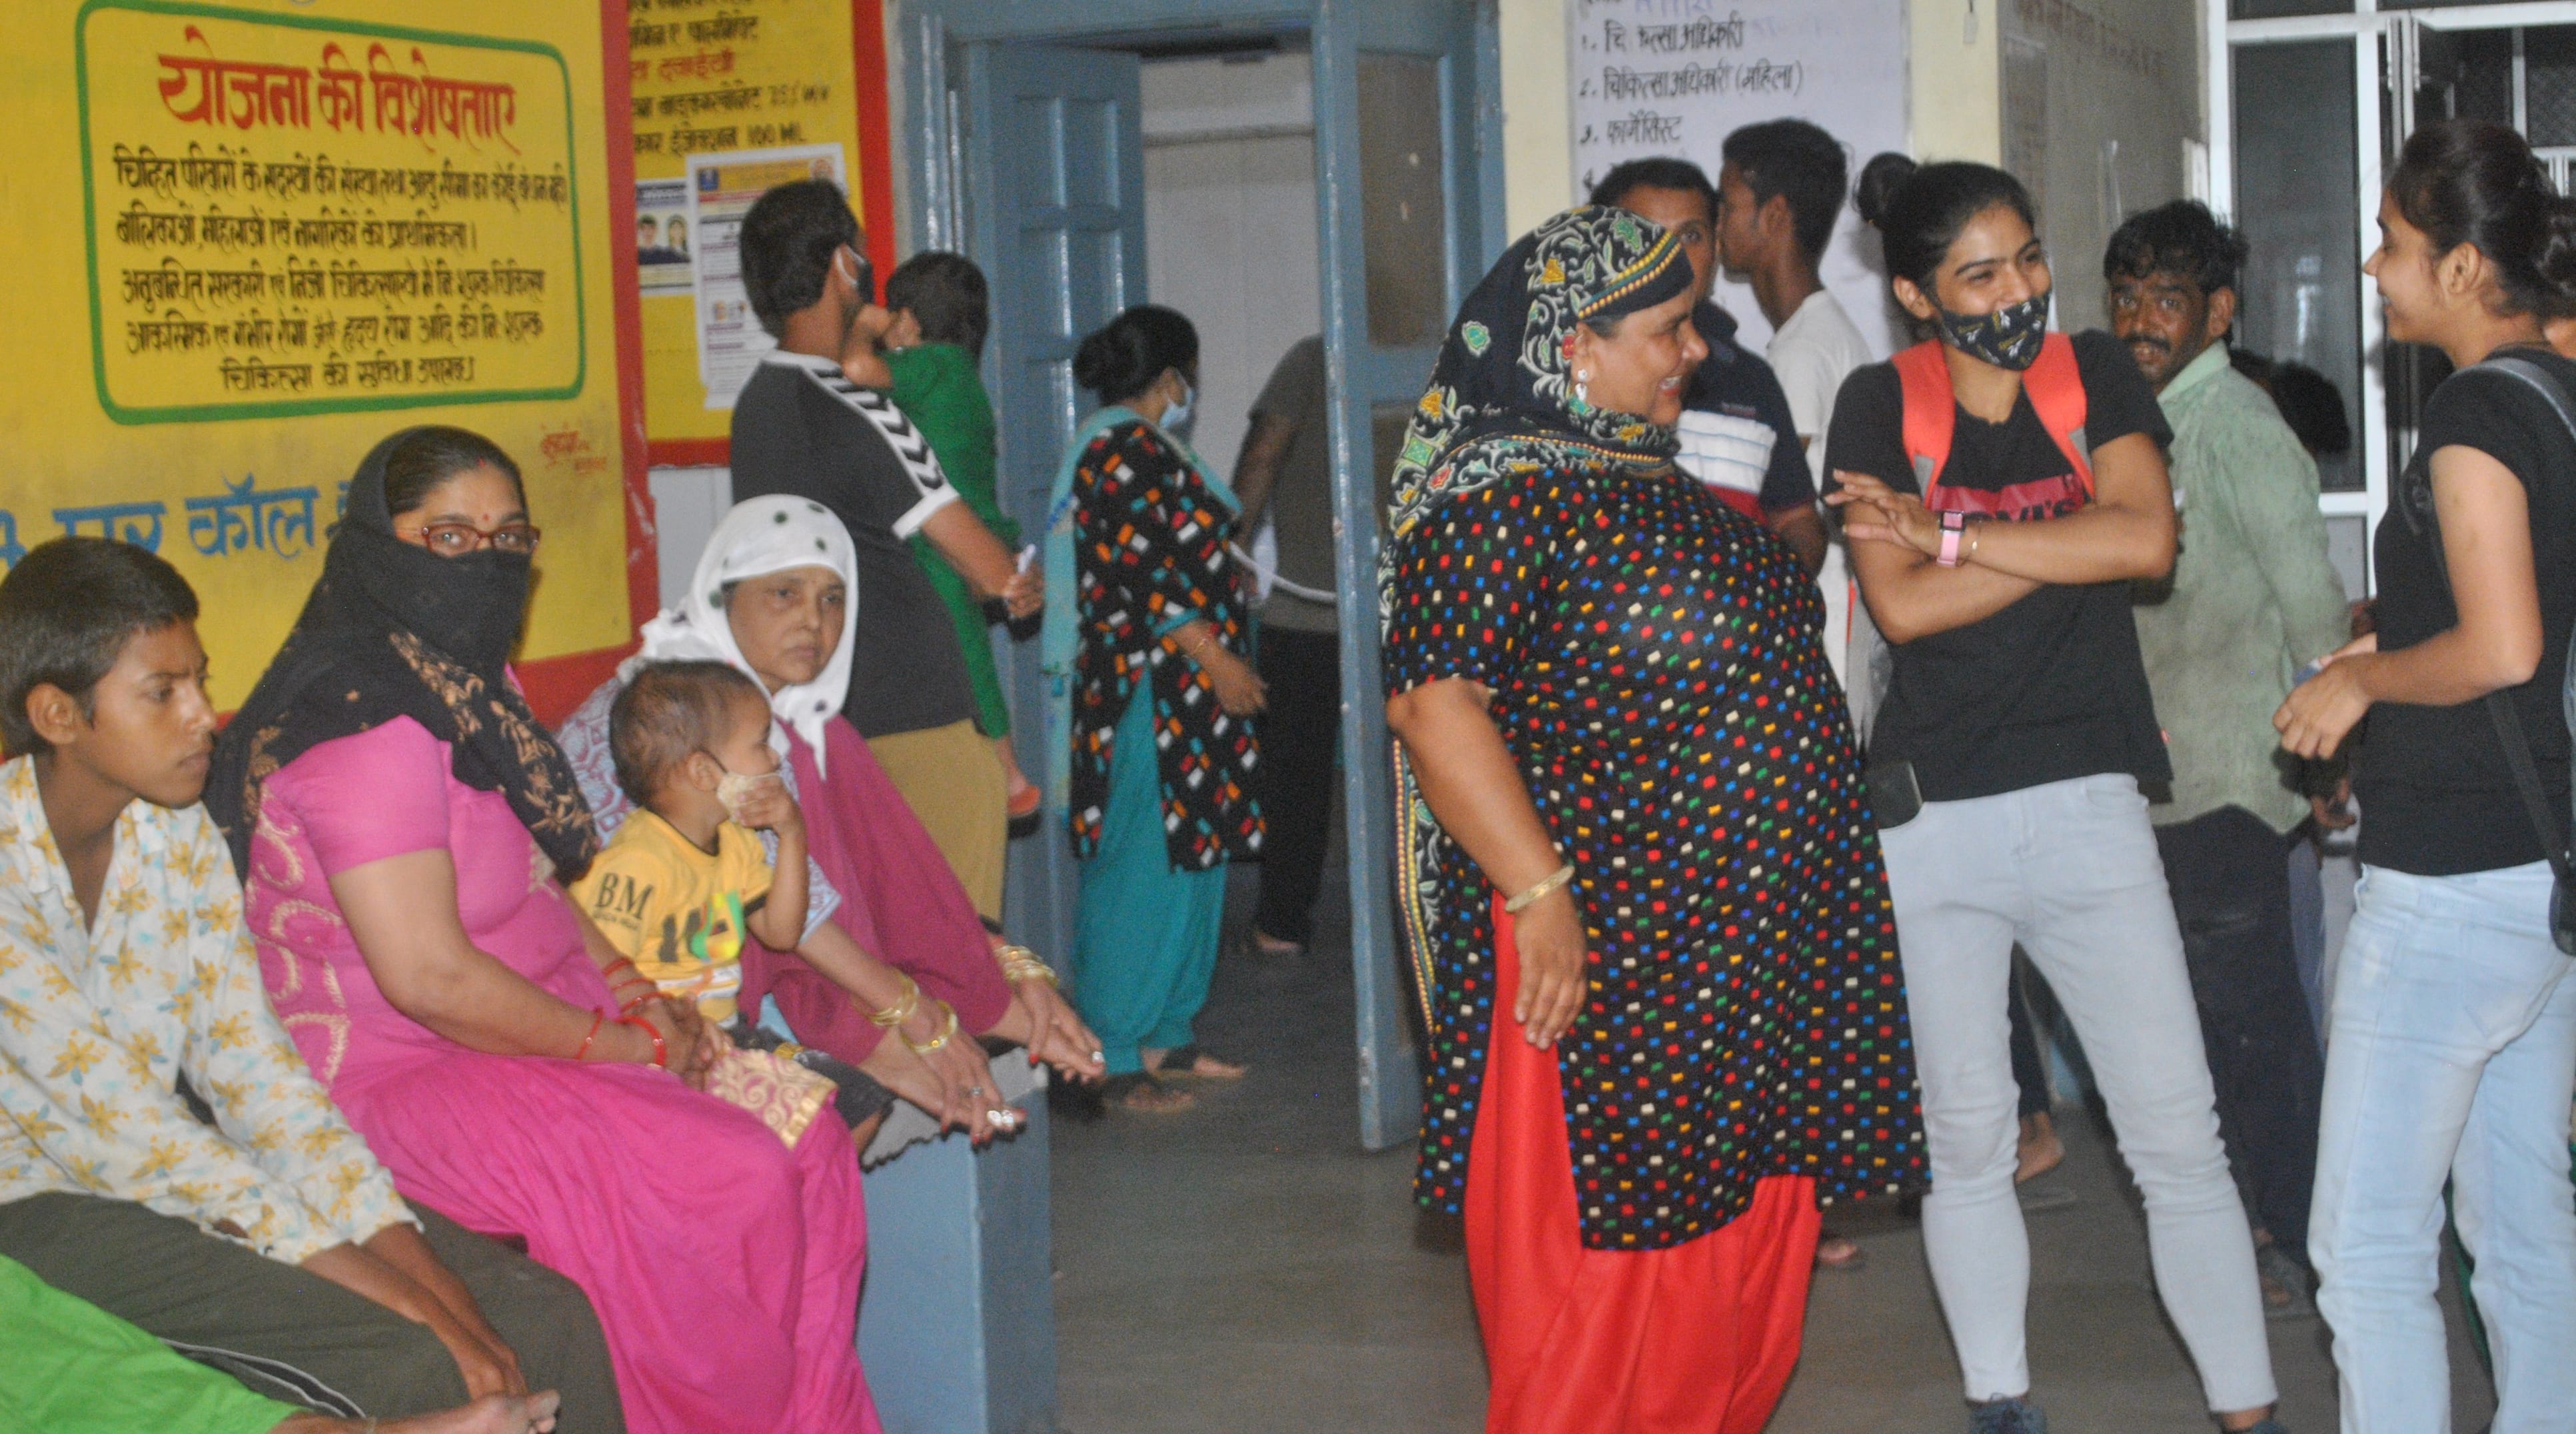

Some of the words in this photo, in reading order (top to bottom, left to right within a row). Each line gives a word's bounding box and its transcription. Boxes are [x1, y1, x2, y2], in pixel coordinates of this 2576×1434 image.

[158, 25, 313, 130] योजना
[317, 41, 364, 133] की
[185, 468, 321, 561] कॉल
